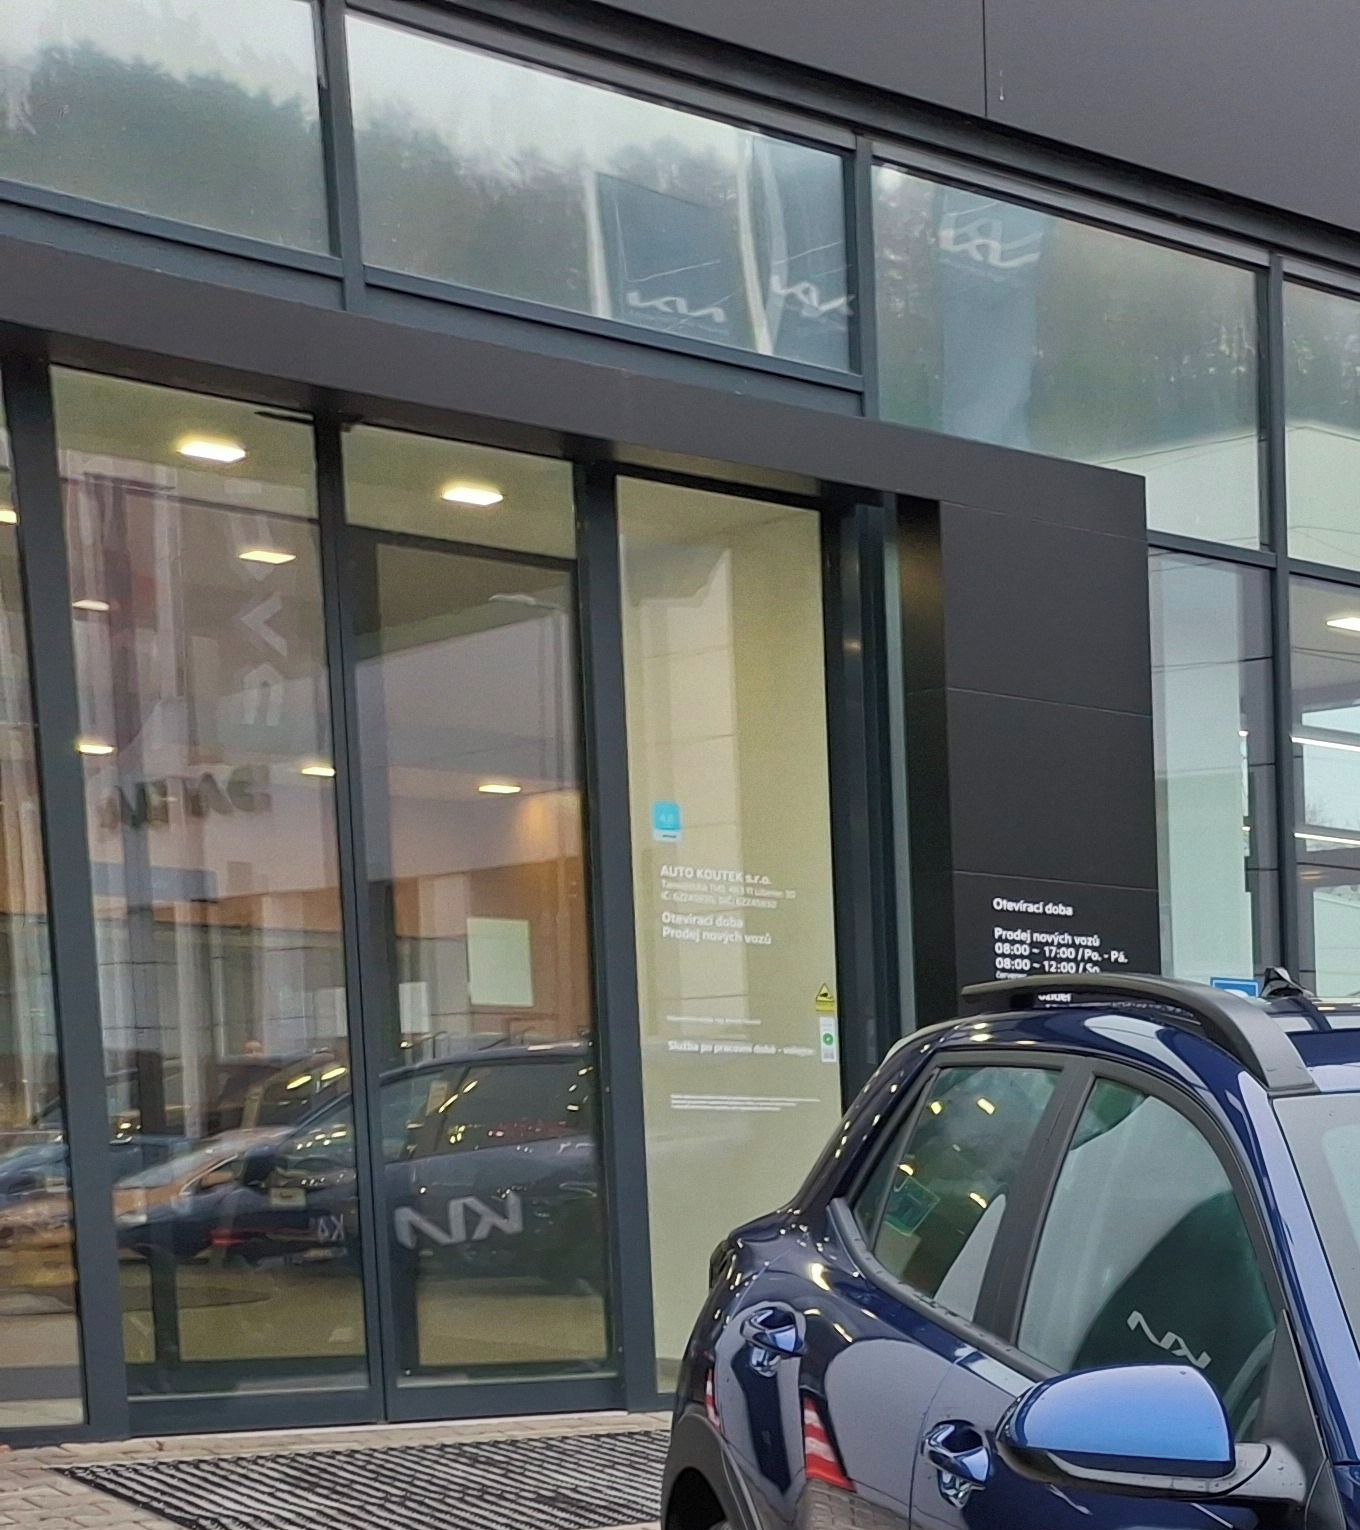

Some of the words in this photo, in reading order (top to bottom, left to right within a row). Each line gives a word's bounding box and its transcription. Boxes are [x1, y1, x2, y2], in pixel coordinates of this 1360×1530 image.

[660, 865, 694, 879] AUTO
[696, 868, 743, 882] KOUTEK
[745, 874, 772, 885] s.r.o.
[992, 897, 1043, 913] Otevírací
[1045, 902, 1073, 916] doba
[662, 911, 713, 927] Otevírací
[715, 915, 743, 928] doba
[662, 926, 700, 942] Prodej
[702, 930, 742, 944] nových
[744, 932, 772, 945] vozů
[994, 927, 1031, 943] Prodej
[1033, 931, 1072, 945] nových
[1074, 934, 1100, 947] vozů
[994, 943, 1030, 955] 08:00
[1043, 946, 1076, 959] 17:00
[1110, 951, 1128, 963] Pá.
[995, 957, 1031, 970] 08:00
[1043, 961, 1076, 973] 12:00
